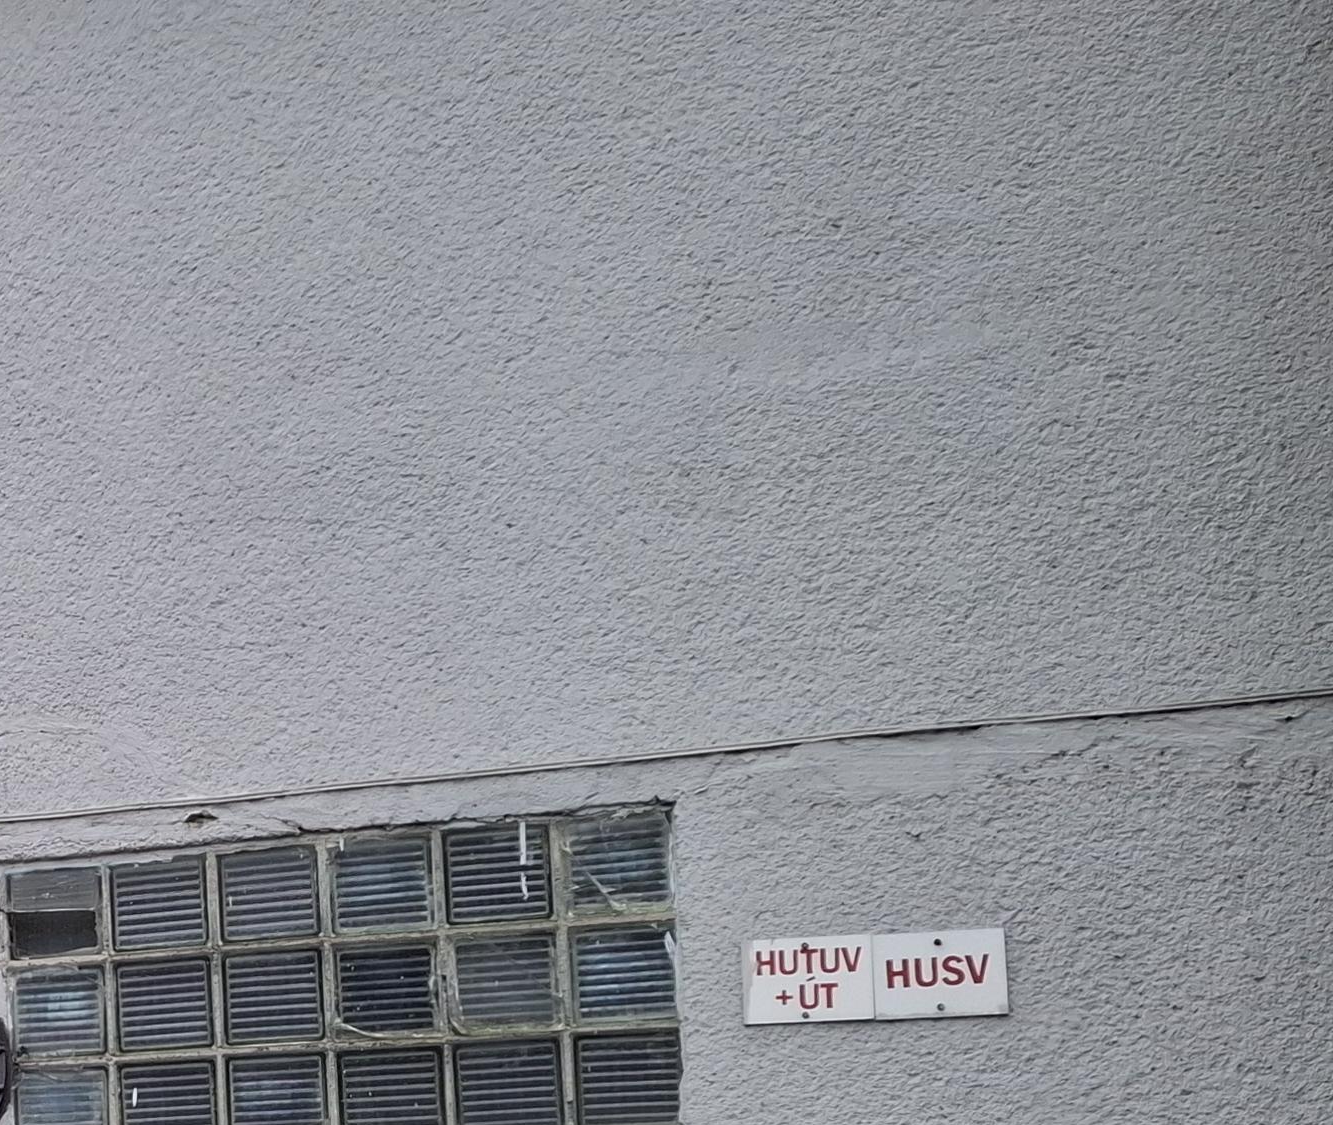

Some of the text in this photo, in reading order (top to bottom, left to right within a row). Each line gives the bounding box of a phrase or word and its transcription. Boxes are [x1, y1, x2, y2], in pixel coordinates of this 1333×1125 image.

[756, 946, 862, 976] HUTUV
[886, 953, 990, 989] HUSV
[800, 976, 839, 1010] ÚT
